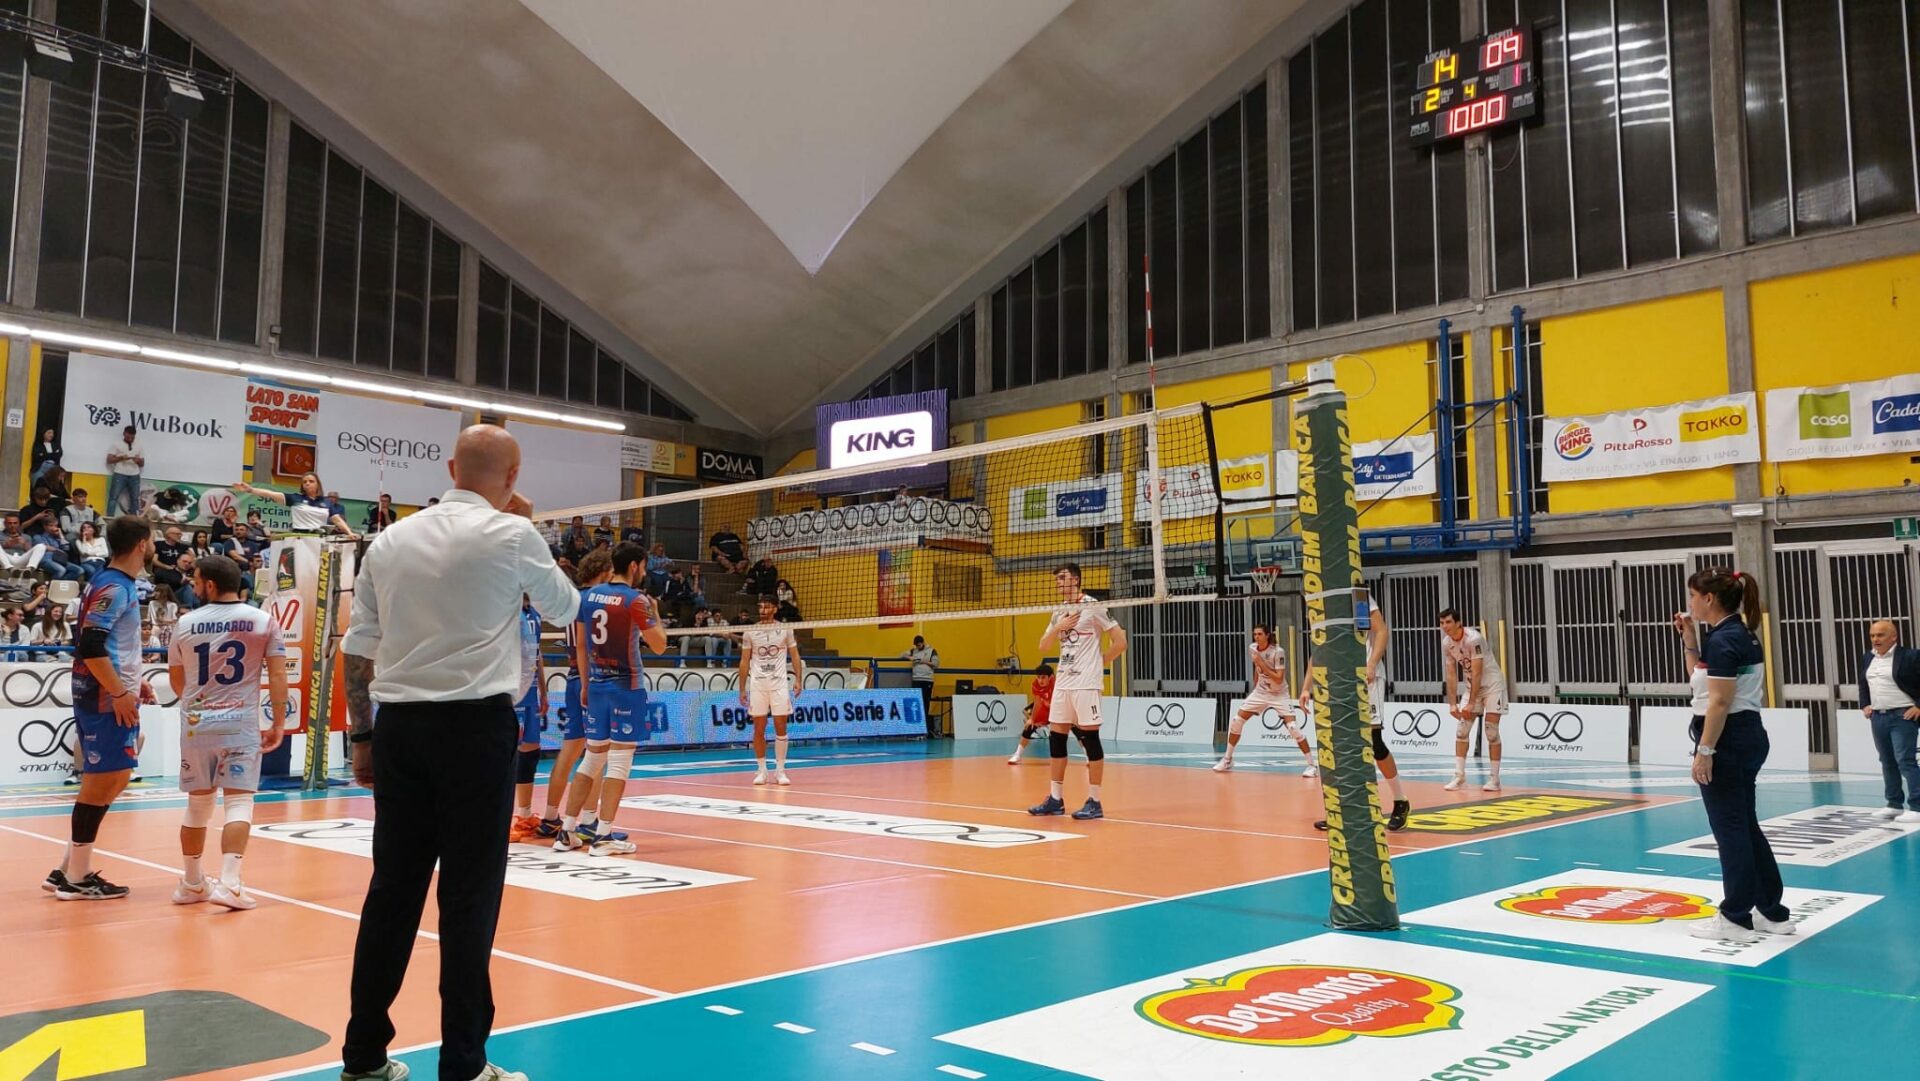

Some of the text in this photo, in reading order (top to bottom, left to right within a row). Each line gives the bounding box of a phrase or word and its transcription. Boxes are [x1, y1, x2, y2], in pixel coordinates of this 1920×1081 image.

[1425, 48, 1450, 63] LOCALI
[1486, 34, 1520, 69] 09
[1434, 53, 1458, 84] 14
[1425, 86, 1441, 113] 2
[1463, 82, 1476, 99] 4
[129, 410, 223, 438] WuBook
[1810, 414, 1849, 426] casa
[1875, 400, 1920, 424] Cadd
[337, 431, 441, 461] essence
[847, 428, 915, 453] KING
[1558, 426, 1591, 445] BURGER
[1560, 434, 1593, 455] KING
[1603, 437, 1673, 453] PittaRosso
[370, 458, 409, 469] HOTELS
[702, 452, 756, 475] DOMA
[1294, 414, 1320, 516] BANCA
[318, 550, 330, 600] BANCA
[595, 593, 622, 606] FRANCO
[191, 620, 254, 635] LOMBARDO
[591, 609, 608, 645] 3
[193, 639, 246, 686] 13
[309, 671, 321, 721] BANCA
[844, 700, 884, 722] Serie
[890, 701, 900, 719] A
[1390, 738, 1439, 748] smartsystem
[1523, 743, 1583, 753] smartsystem
[1312, 666, 1356, 906] CREDEM BANCA
[1185, 972, 1398, 1035] Del Monte
[1311, 997, 1409, 1027] Quality
[1419, 985, 1664, 1081] STO DELLA NATURA
